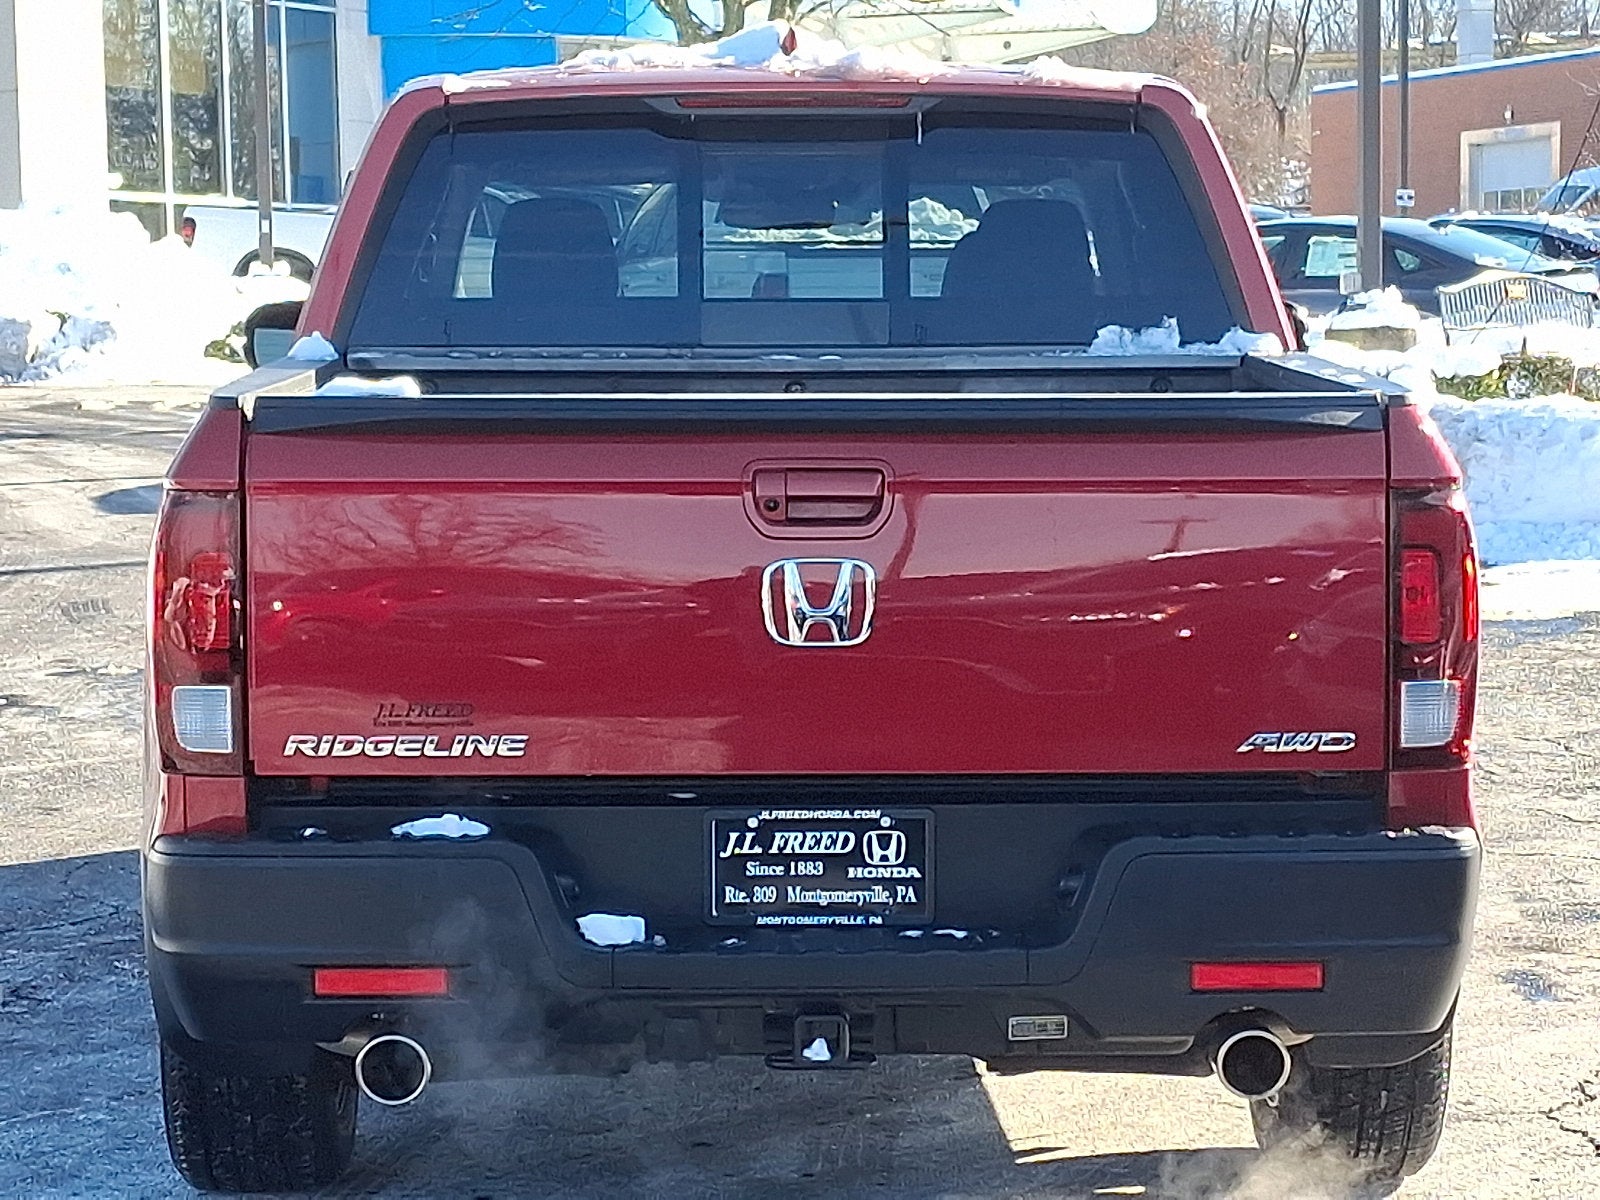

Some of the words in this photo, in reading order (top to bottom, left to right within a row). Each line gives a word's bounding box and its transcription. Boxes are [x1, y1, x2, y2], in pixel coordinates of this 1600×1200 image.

[405, 702, 474, 718] FREED
[283, 735, 529, 757] RIDGELINE
[1236, 732, 1356, 753] AWD
[768, 831, 856, 854] FREED
[745, 861, 785, 876] Since
[847, 867, 922, 878] HONDA
[723, 885, 751, 903] Rte.
[786, 885, 893, 906] Montgomeryville,
[896, 885, 917, 903] PA
